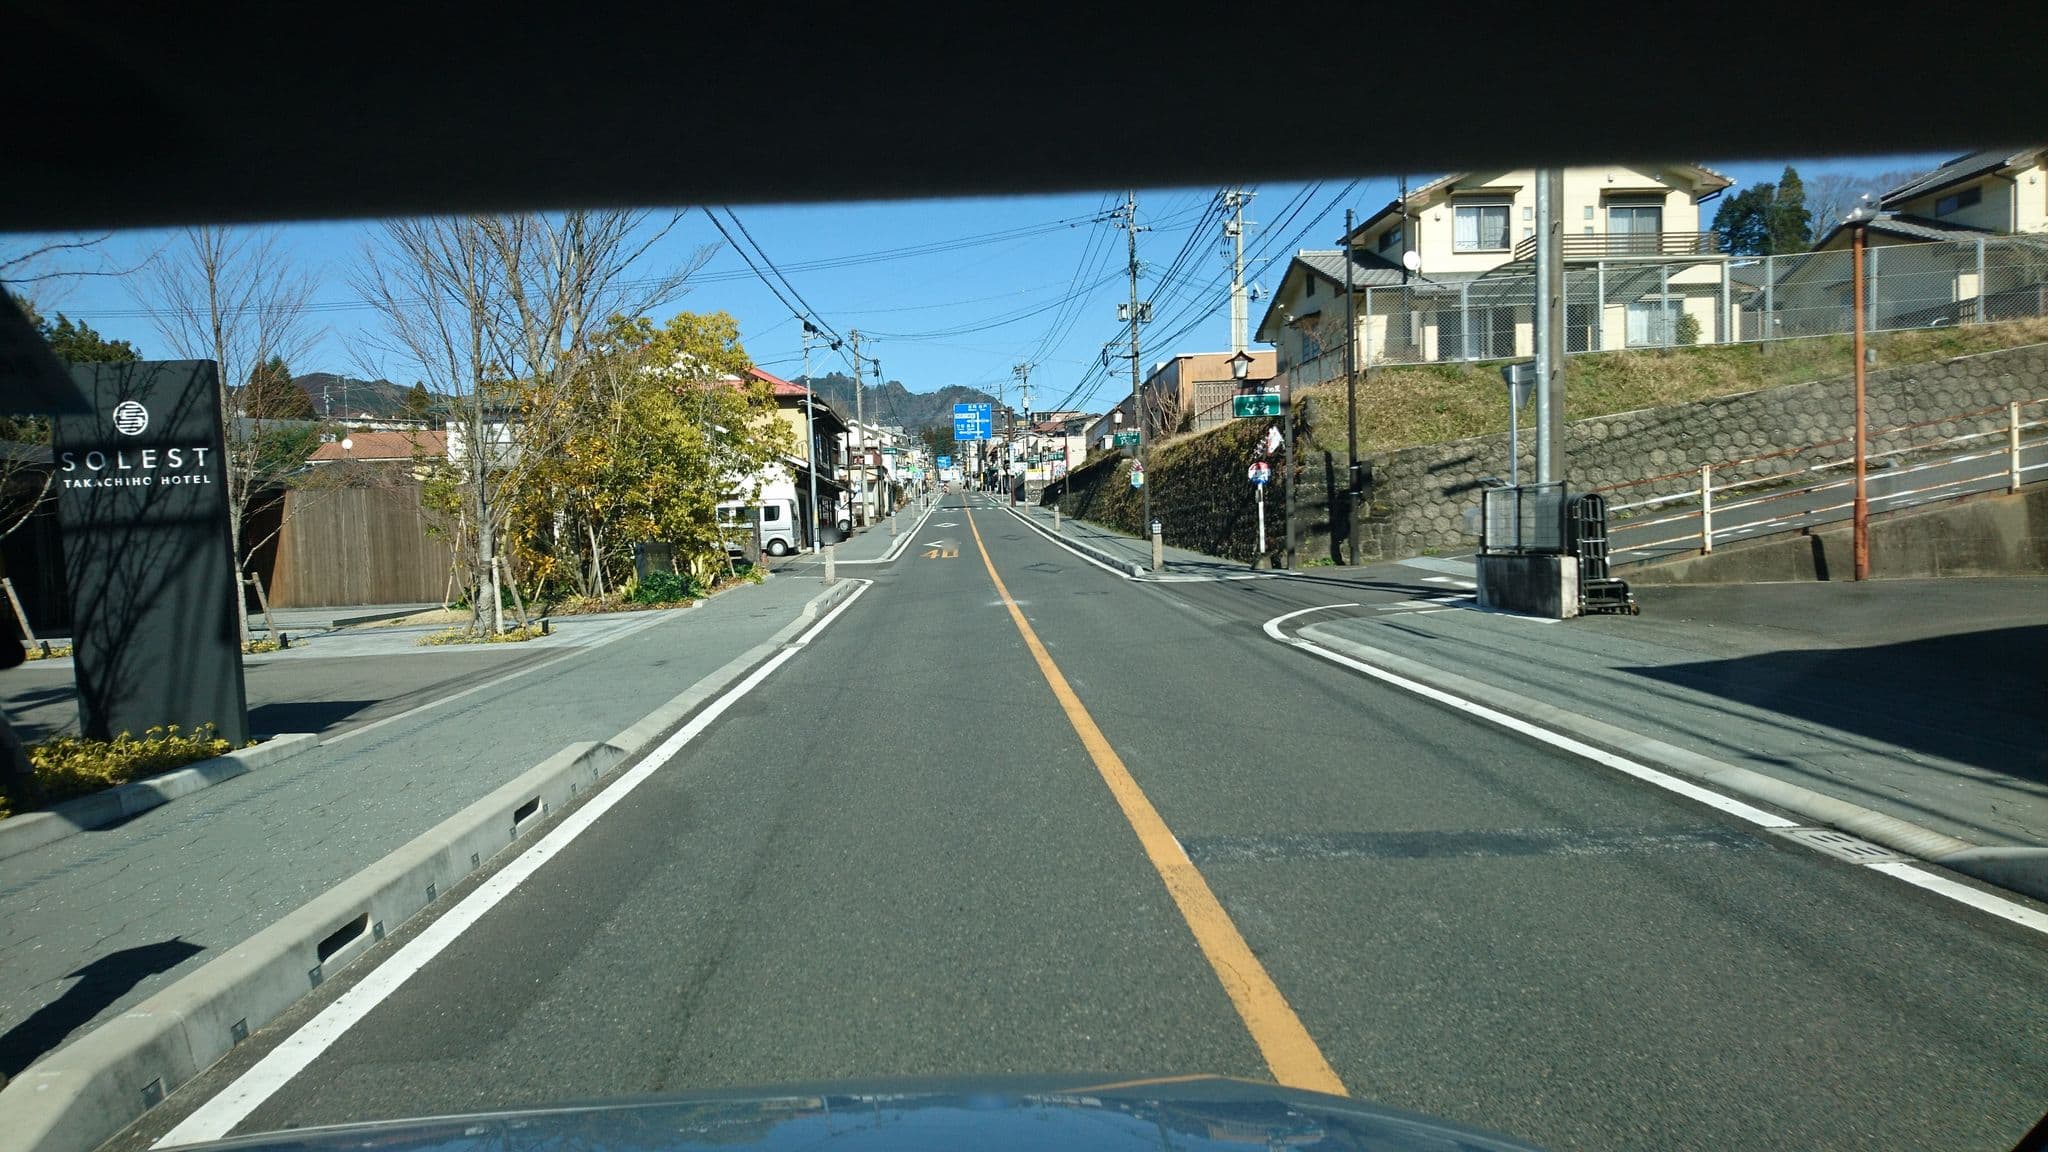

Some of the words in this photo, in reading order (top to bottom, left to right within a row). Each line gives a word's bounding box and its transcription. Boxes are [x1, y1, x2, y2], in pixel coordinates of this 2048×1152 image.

[61, 447, 209, 472] SOLEST
[63, 477, 153, 489] TAKACHIHO
[161, 474, 211, 486] HOTEL
